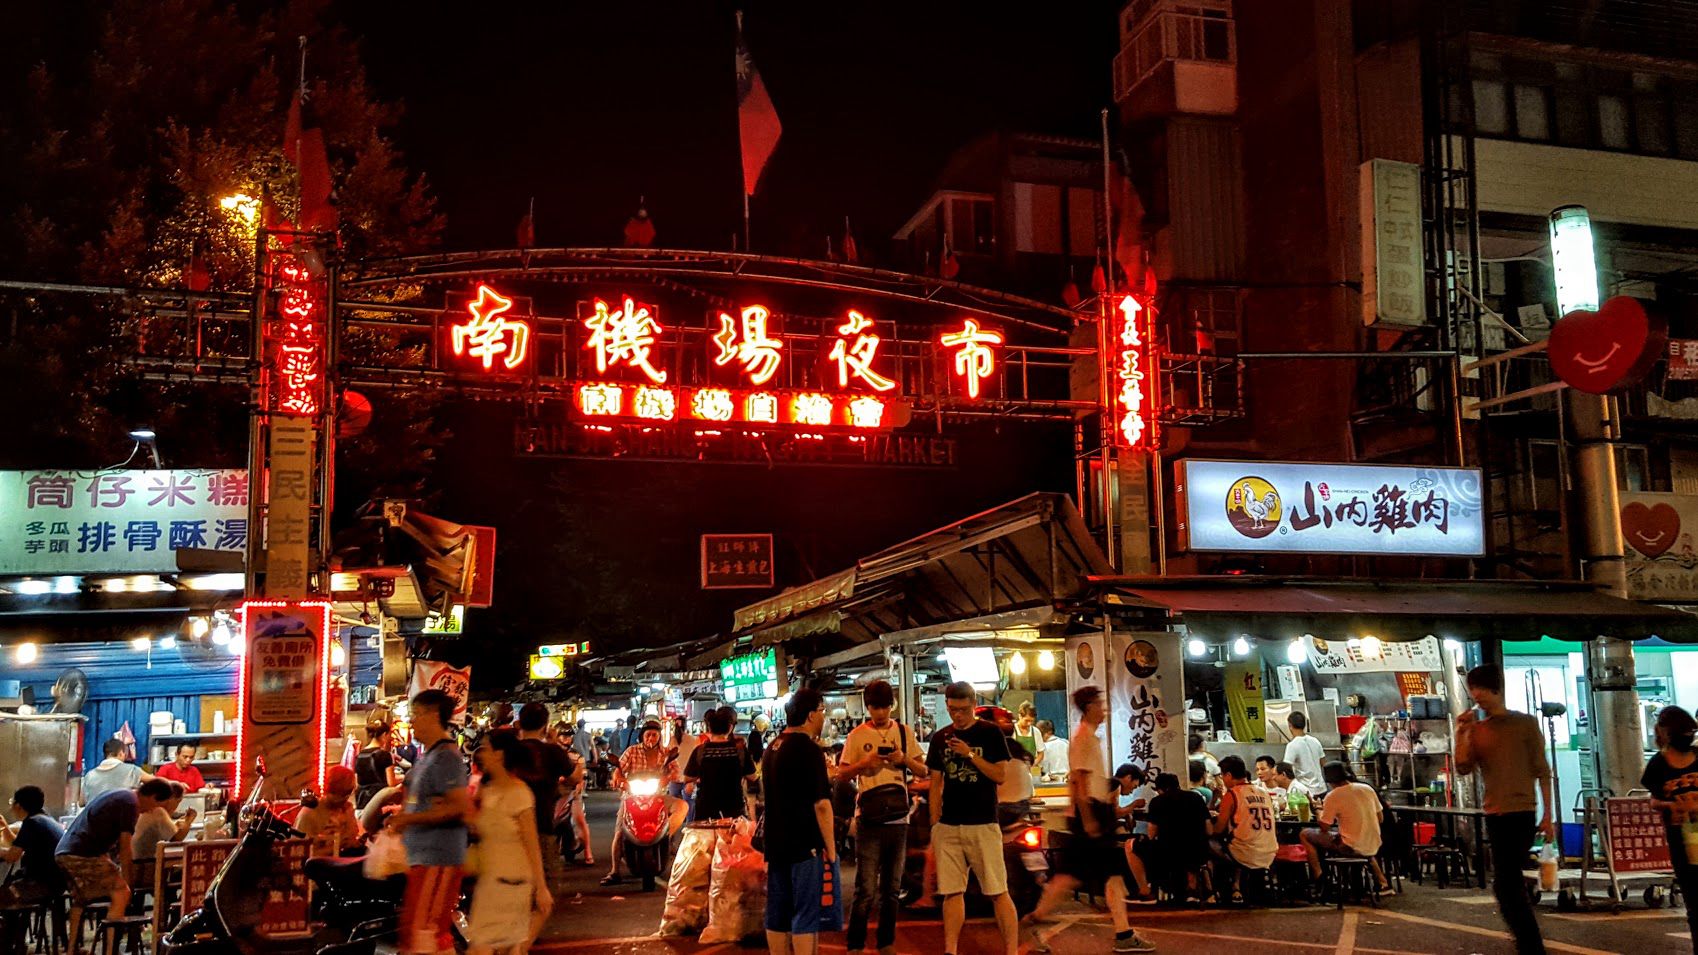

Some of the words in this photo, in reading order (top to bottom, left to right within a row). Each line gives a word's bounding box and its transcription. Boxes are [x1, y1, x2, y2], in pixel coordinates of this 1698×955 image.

[452, 284, 1004, 398] 南機場夜市
[580, 385, 885, 428] 南機場自治會
[26, 474, 248, 509] 筒仔米糕
[270, 426, 307, 589] 三民主義
[1289, 480, 1449, 535] 山內雞肉
[26, 521, 70, 536] 冬瓜
[77, 519, 247, 553] 排骨酥湯
[25, 539, 69, 554] 芋頭
[1249, 807, 1272, 831] 35
